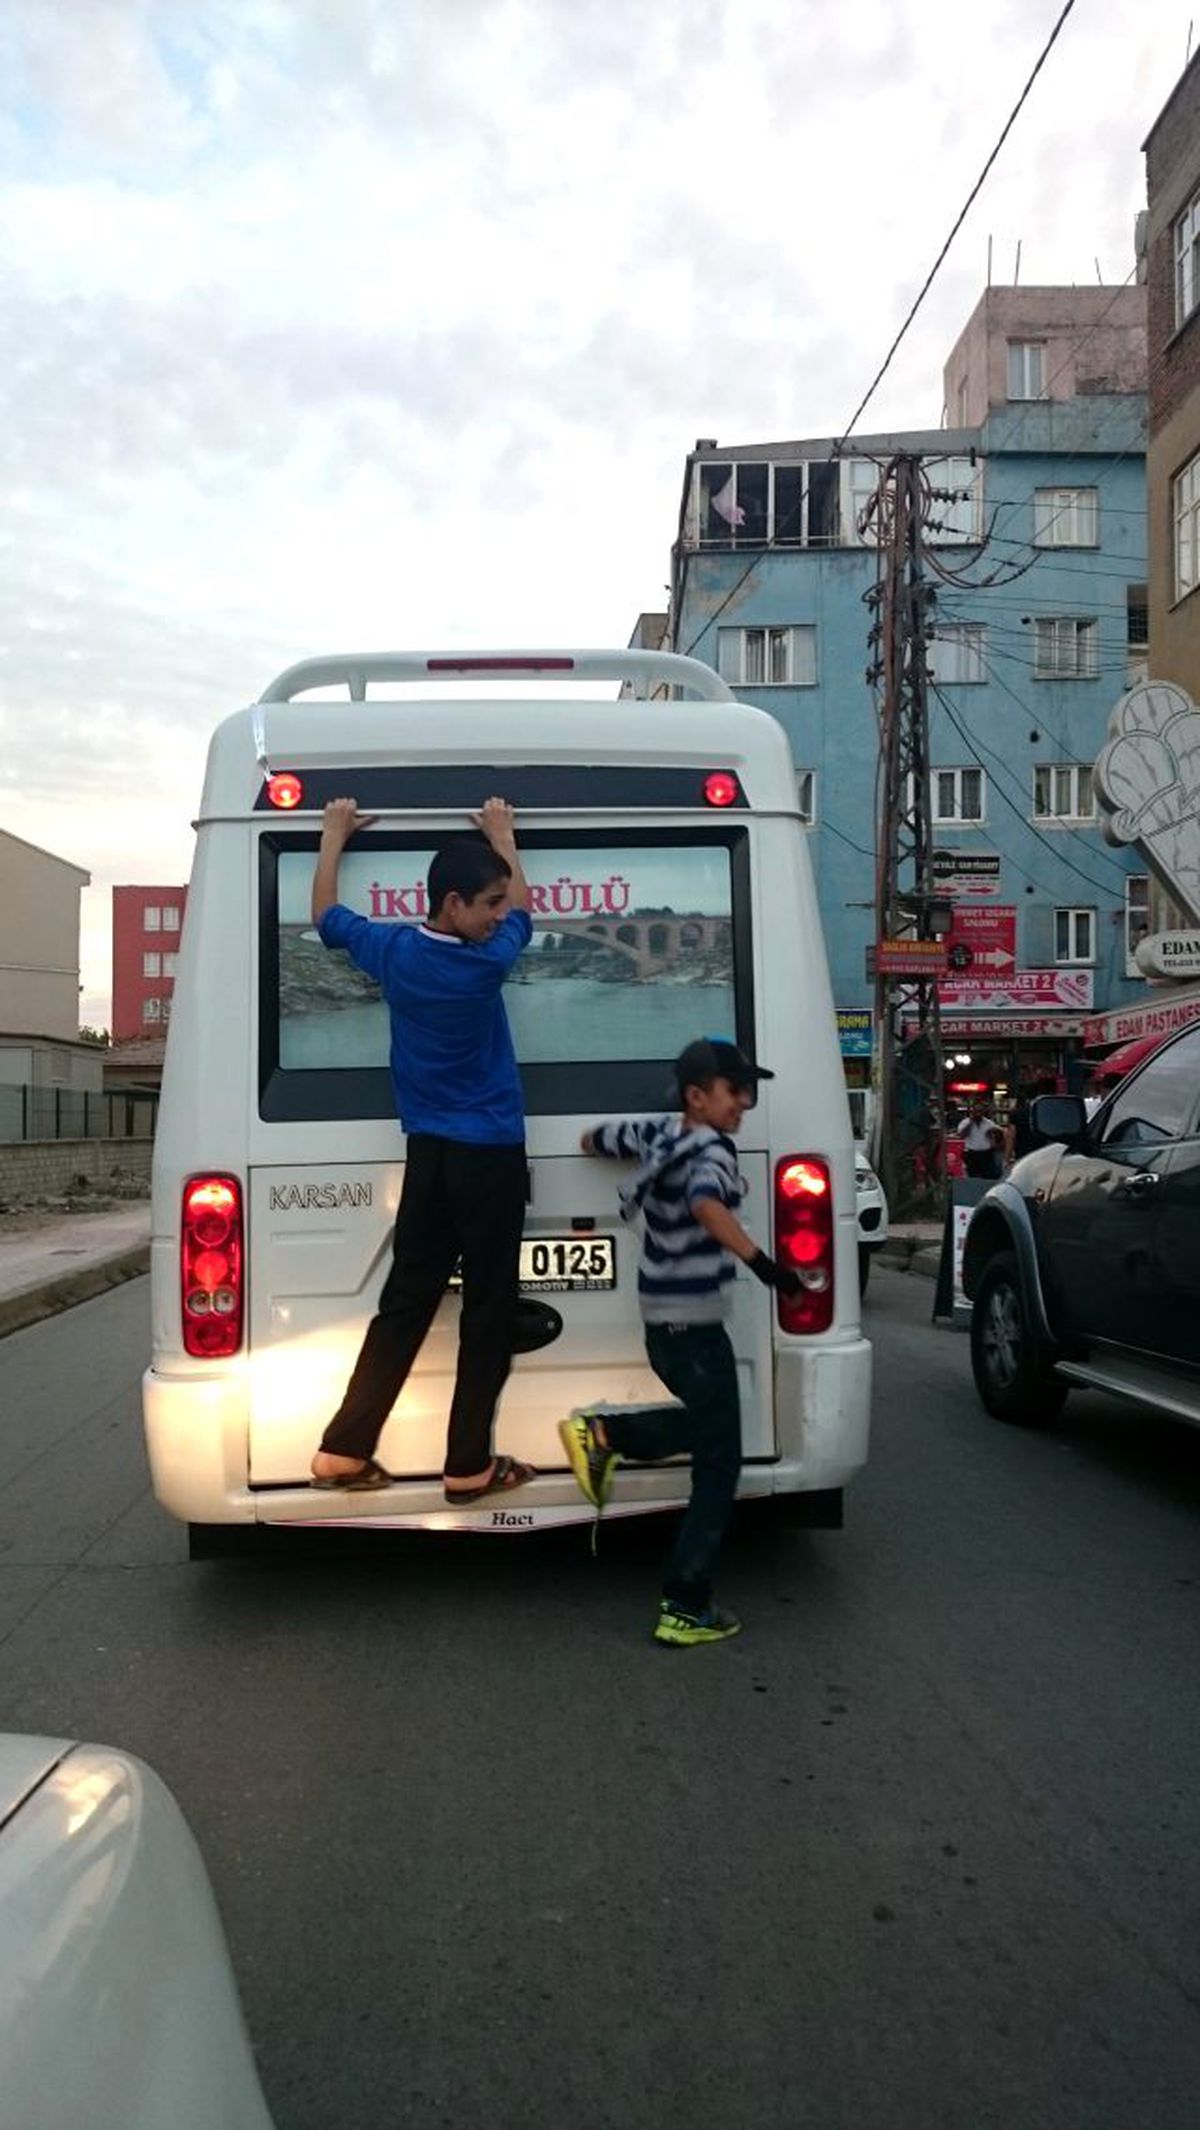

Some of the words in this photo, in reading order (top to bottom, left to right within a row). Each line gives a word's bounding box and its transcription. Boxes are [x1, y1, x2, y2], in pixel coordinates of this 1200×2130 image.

[369, 881, 429, 918] İKİ
[526, 875, 631, 915] RÜLÜ
[1041, 974, 1050, 988] 2
[971, 1021, 1028, 1034] MARKET
[269, 1182, 373, 1211] KARSAN
[532, 1244, 607, 1276] 0125
